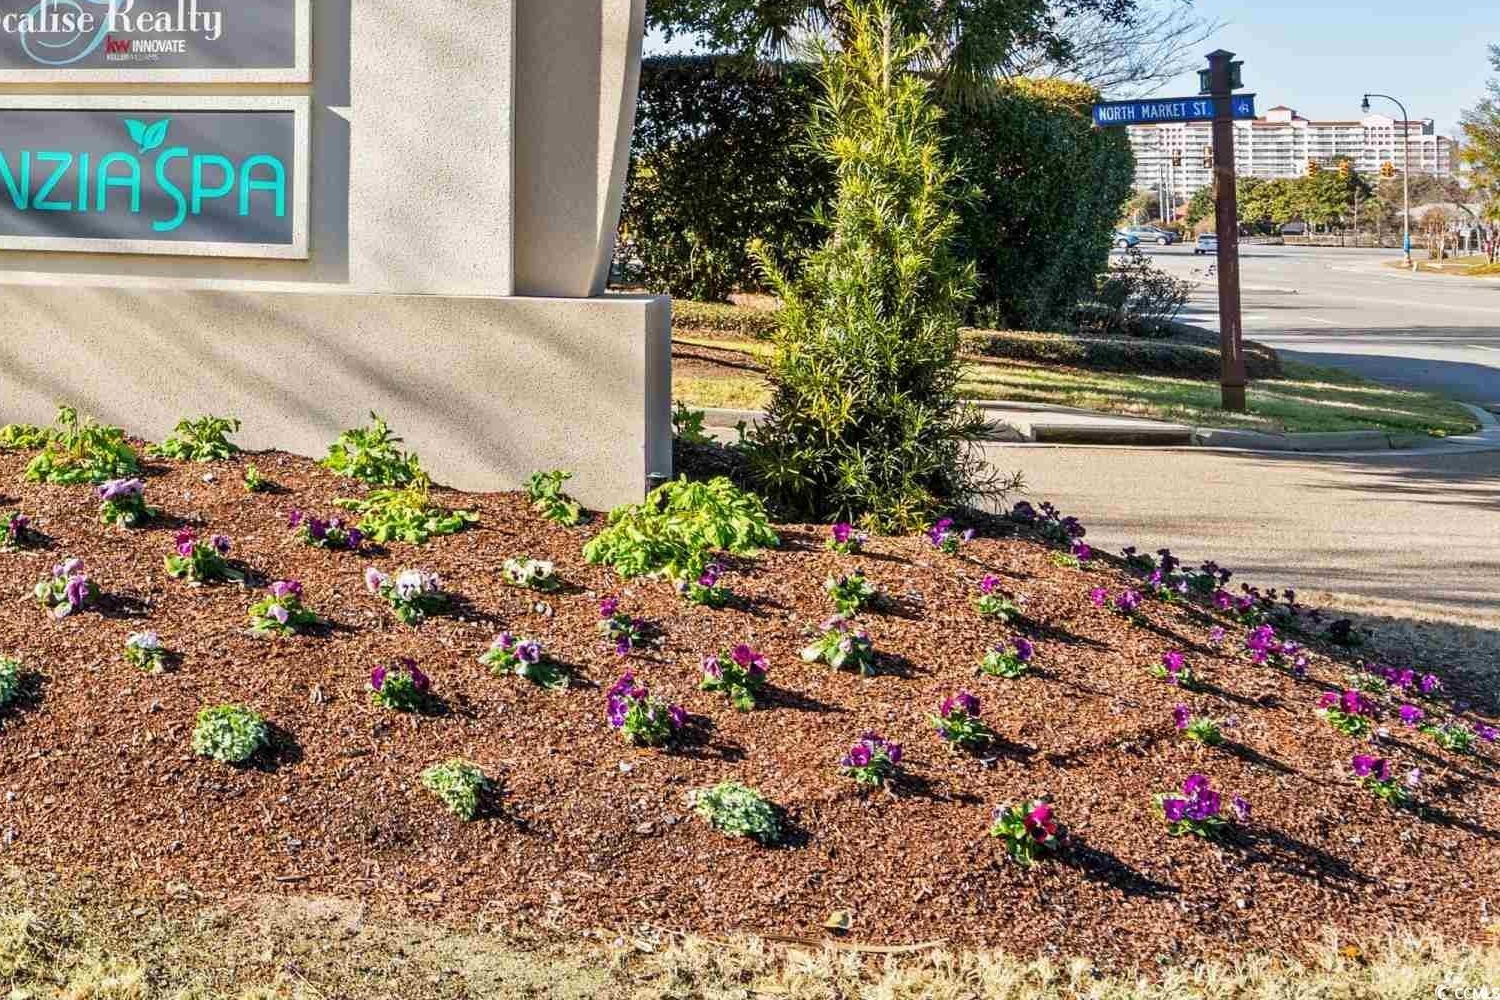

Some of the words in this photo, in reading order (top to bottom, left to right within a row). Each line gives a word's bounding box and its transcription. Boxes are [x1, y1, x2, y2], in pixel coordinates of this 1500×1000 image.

[132, 39, 186, 53] INNOVATE
[1099, 105, 1134, 121] NORTH
[1141, 102, 1186, 119] MARKET
[1193, 101, 1211, 116] ST.
[151, 146, 286, 232] SPA
